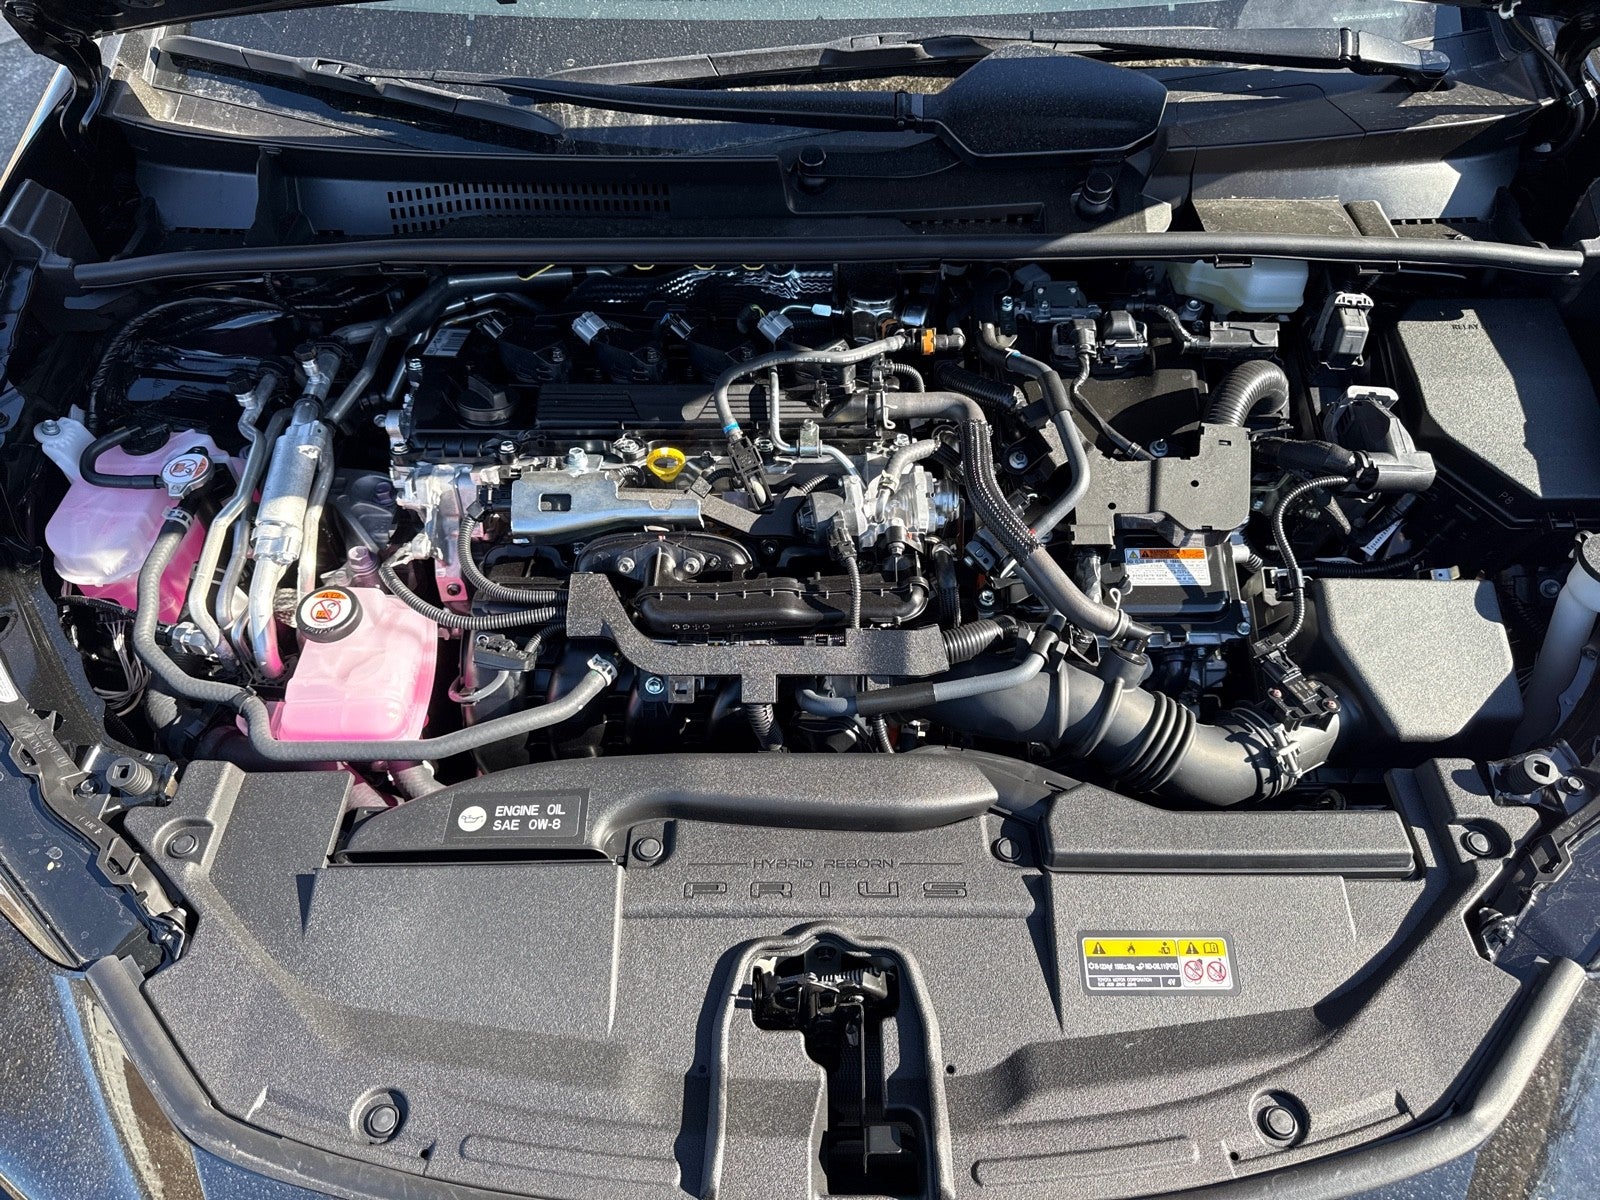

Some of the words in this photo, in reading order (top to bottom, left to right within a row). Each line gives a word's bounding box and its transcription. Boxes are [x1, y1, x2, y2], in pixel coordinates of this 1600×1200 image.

[495, 804, 540, 817] ENGINE
[546, 803, 566, 816] OIL
[492, 819, 521, 831] SAE
[752, 858, 814, 869] HYBRID
[823, 858, 894, 869] REBORN
[683, 881, 967, 899] PRIUS
